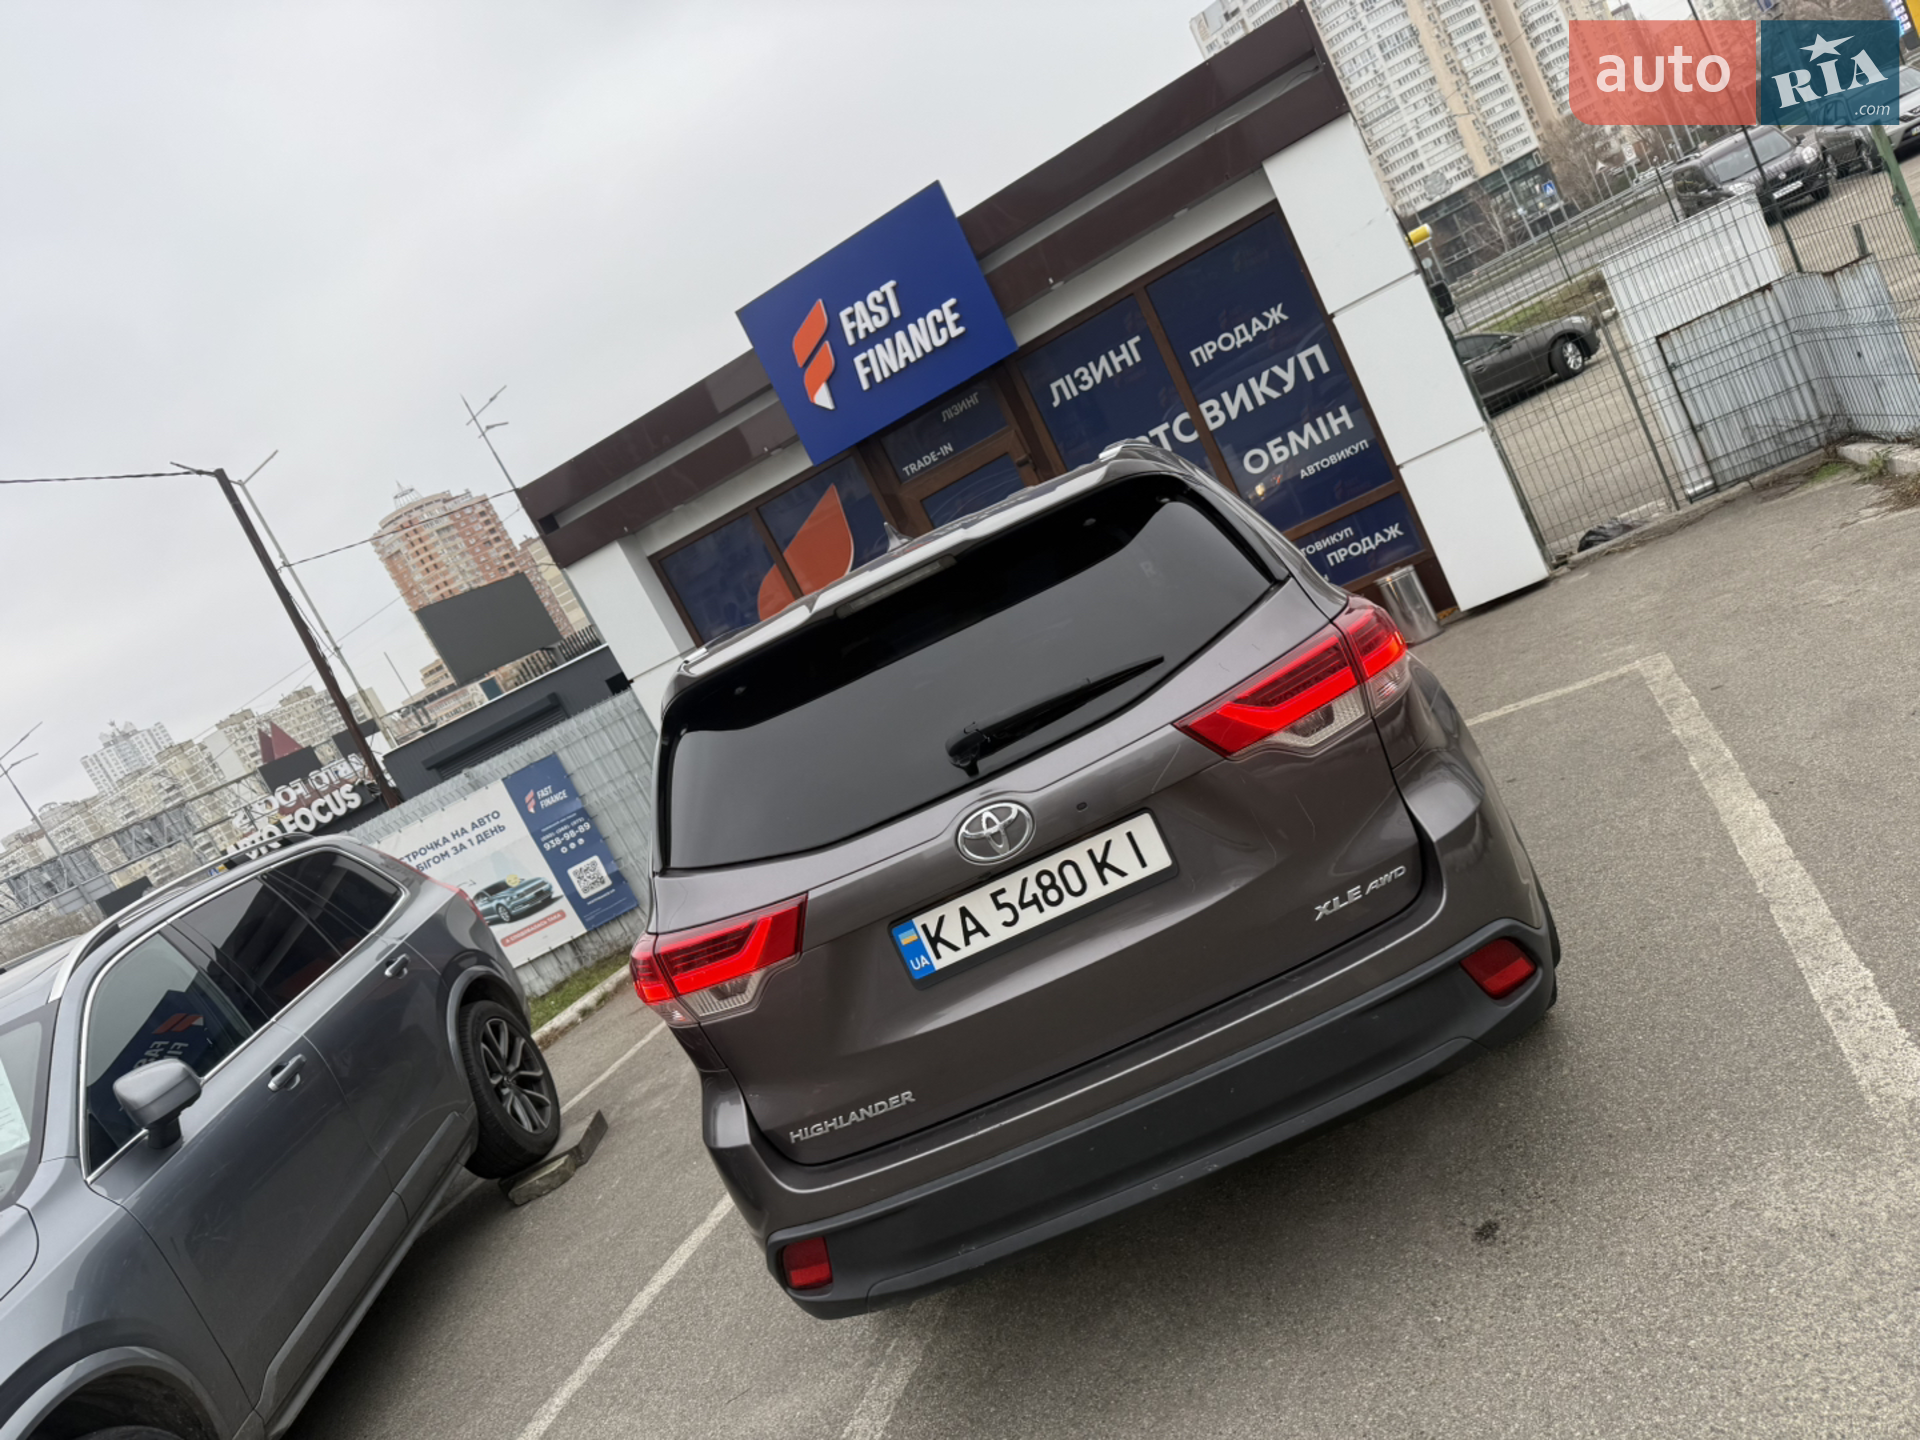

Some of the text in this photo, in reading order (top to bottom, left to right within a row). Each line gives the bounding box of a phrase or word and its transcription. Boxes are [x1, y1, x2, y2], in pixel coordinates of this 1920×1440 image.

[838, 280, 898, 346] FAST
[1189, 303, 1290, 367] ПРОДАЖ
[853, 298, 967, 391] FINANCE
[1048, 336, 1143, 408] ЛІЗИНГ
[941, 391, 980, 422] ЛІЗИНГ
[902, 442, 954, 477] TRADE-IN
[1242, 405, 1355, 475] ОБМІН
[1299, 439, 1370, 480] АВТОВИКУП
[1326, 522, 1405, 567] ПРОДАЖ
[280, 783, 362, 834] FOCUS
[536, 785, 553, 799] FAST
[540, 789, 568, 809] FINANCE
[450, 827, 469, 840] НА
[471, 810, 501, 832] АВТО
[451, 843, 468, 856] ЗА
[475, 824, 506, 846] ДЕНЬ
[543, 822, 591, 851] 938-98-89
[910, 831, 1148, 971] UA KA 5480 KI
[1314, 865, 1407, 921] XLE AWD
[789, 1090, 917, 1144] HIGHLANDER
